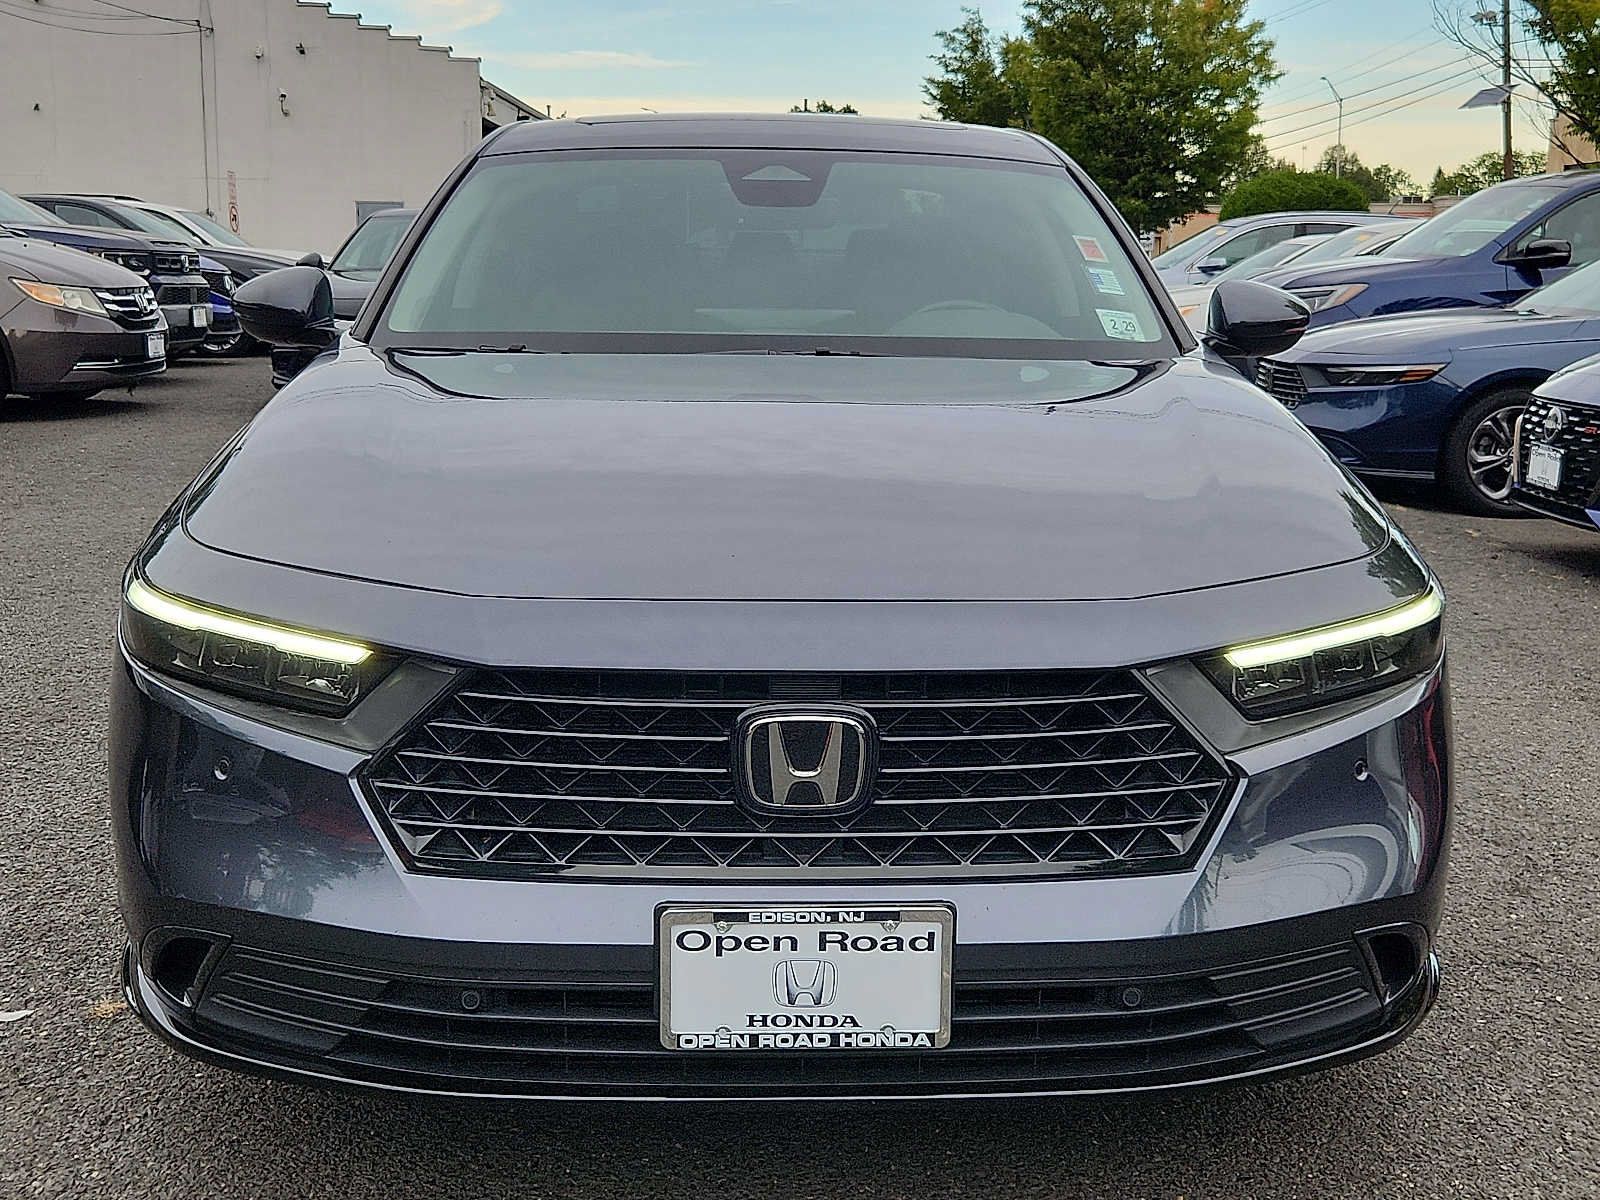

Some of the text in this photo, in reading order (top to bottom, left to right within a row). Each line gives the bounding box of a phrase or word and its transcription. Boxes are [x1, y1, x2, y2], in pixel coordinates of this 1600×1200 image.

[1109, 319, 1137, 333] 2 29
[748, 911, 866, 923] EDISON, NJ
[675, 930, 936, 957] Open Road
[746, 1014, 863, 1028] HONDA
[679, 1033, 932, 1048] OPEN ROAD HONDA
